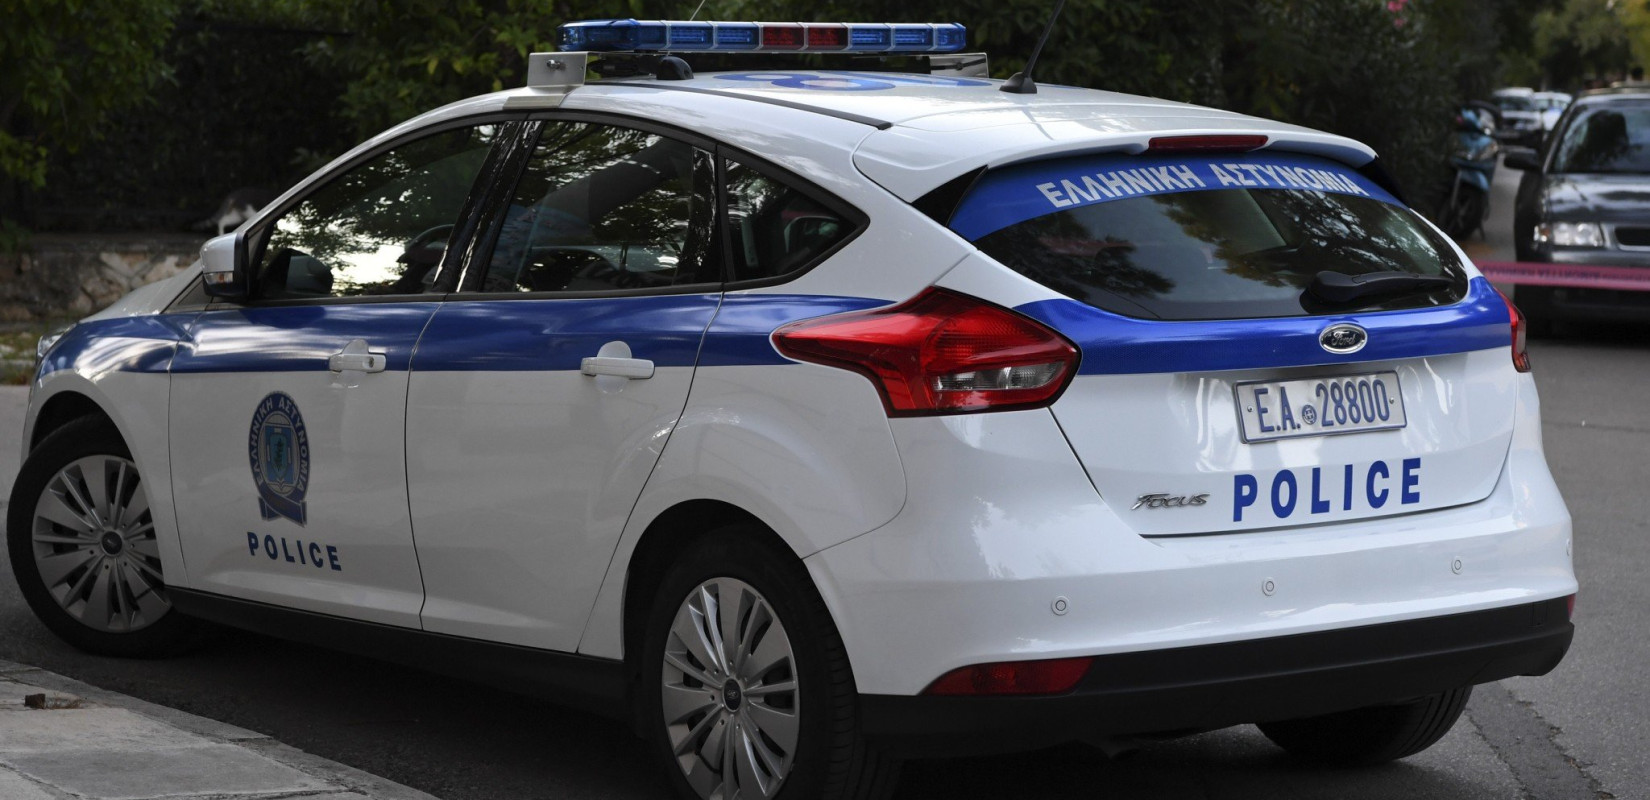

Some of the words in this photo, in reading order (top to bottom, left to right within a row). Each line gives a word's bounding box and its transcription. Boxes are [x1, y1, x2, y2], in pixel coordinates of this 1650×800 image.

[1036, 165, 1205, 209] ΕΛΛΗΝΙΚΗ
[1208, 164, 1370, 197] ΑΣΤΥΝΟΜΙΑ
[1331, 330, 1356, 346] Ford
[1315, 379, 1391, 428] 28800
[1233, 457, 1421, 522] POLICE
[246, 531, 342, 572] POLICE
